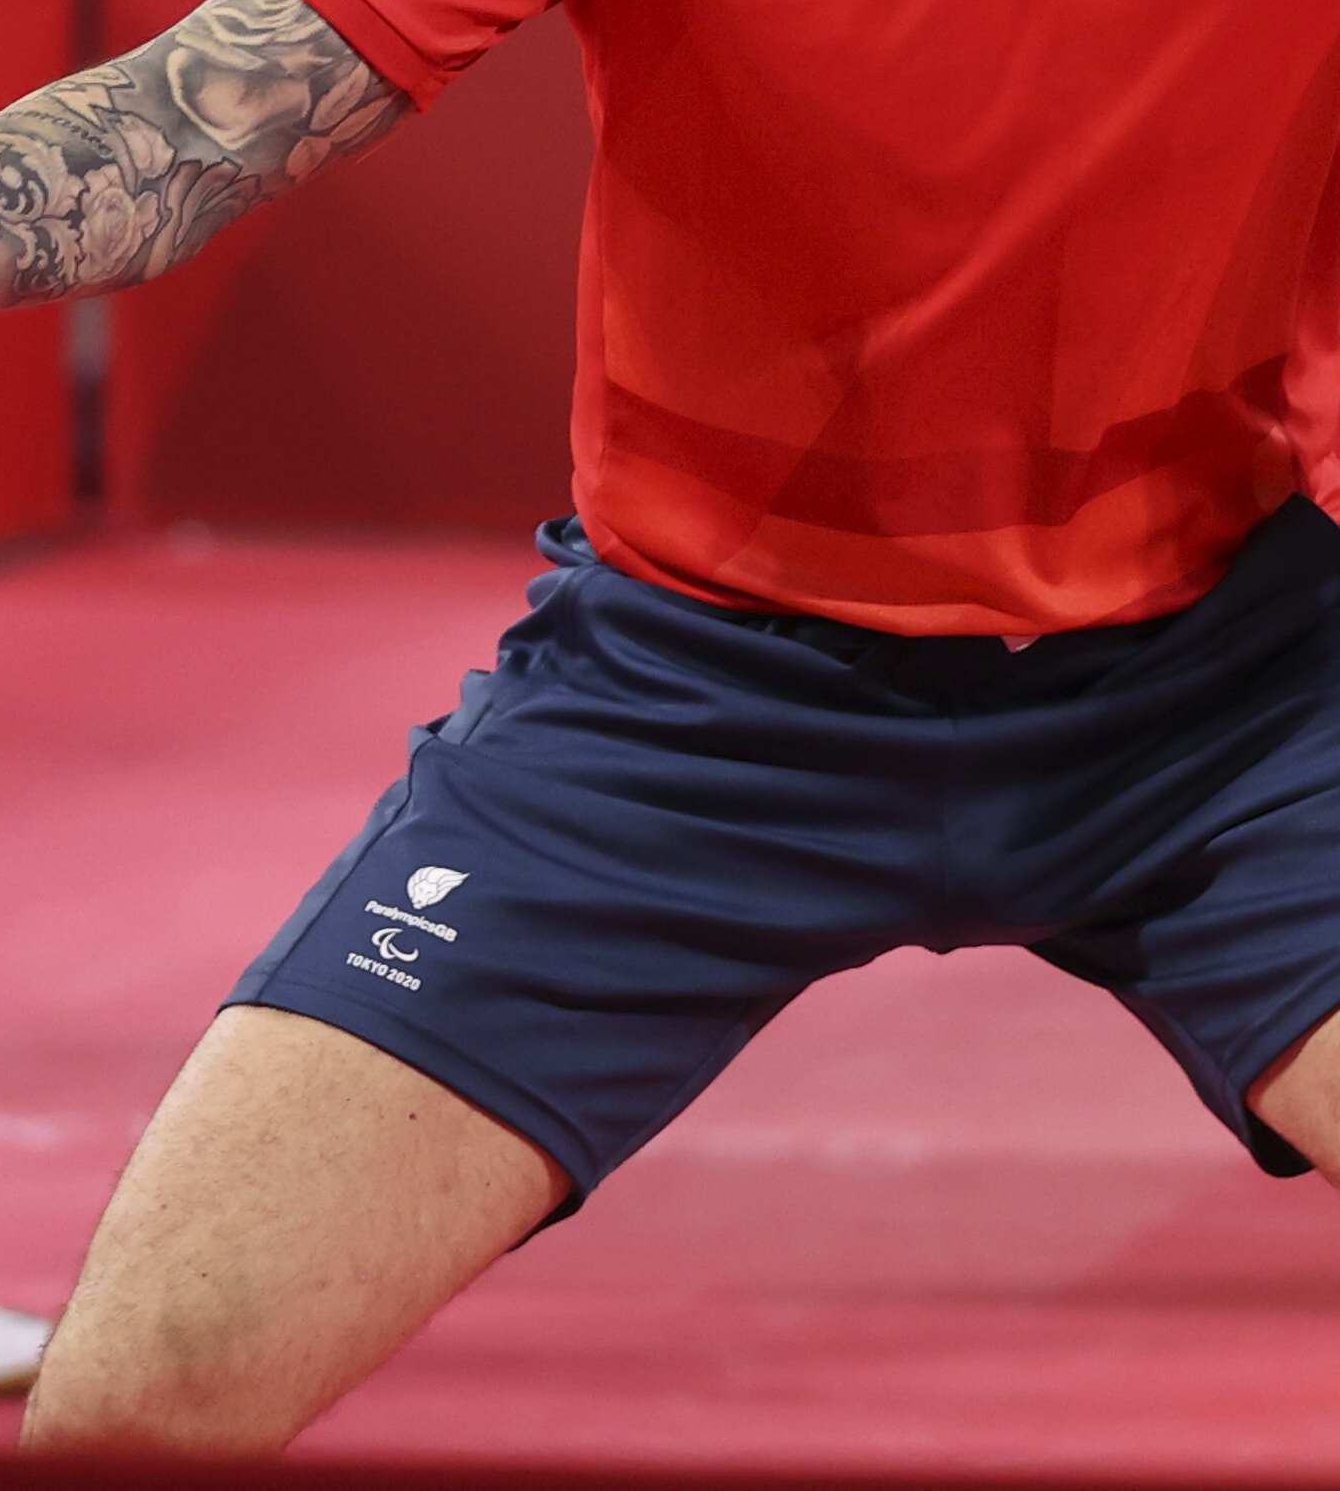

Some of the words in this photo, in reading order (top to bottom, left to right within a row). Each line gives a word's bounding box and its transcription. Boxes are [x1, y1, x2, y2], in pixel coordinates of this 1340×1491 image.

[364, 900, 458, 942] ParalympicsGB
[346, 952, 388, 976] TOKYO
[386, 968, 422, 991] 2020
